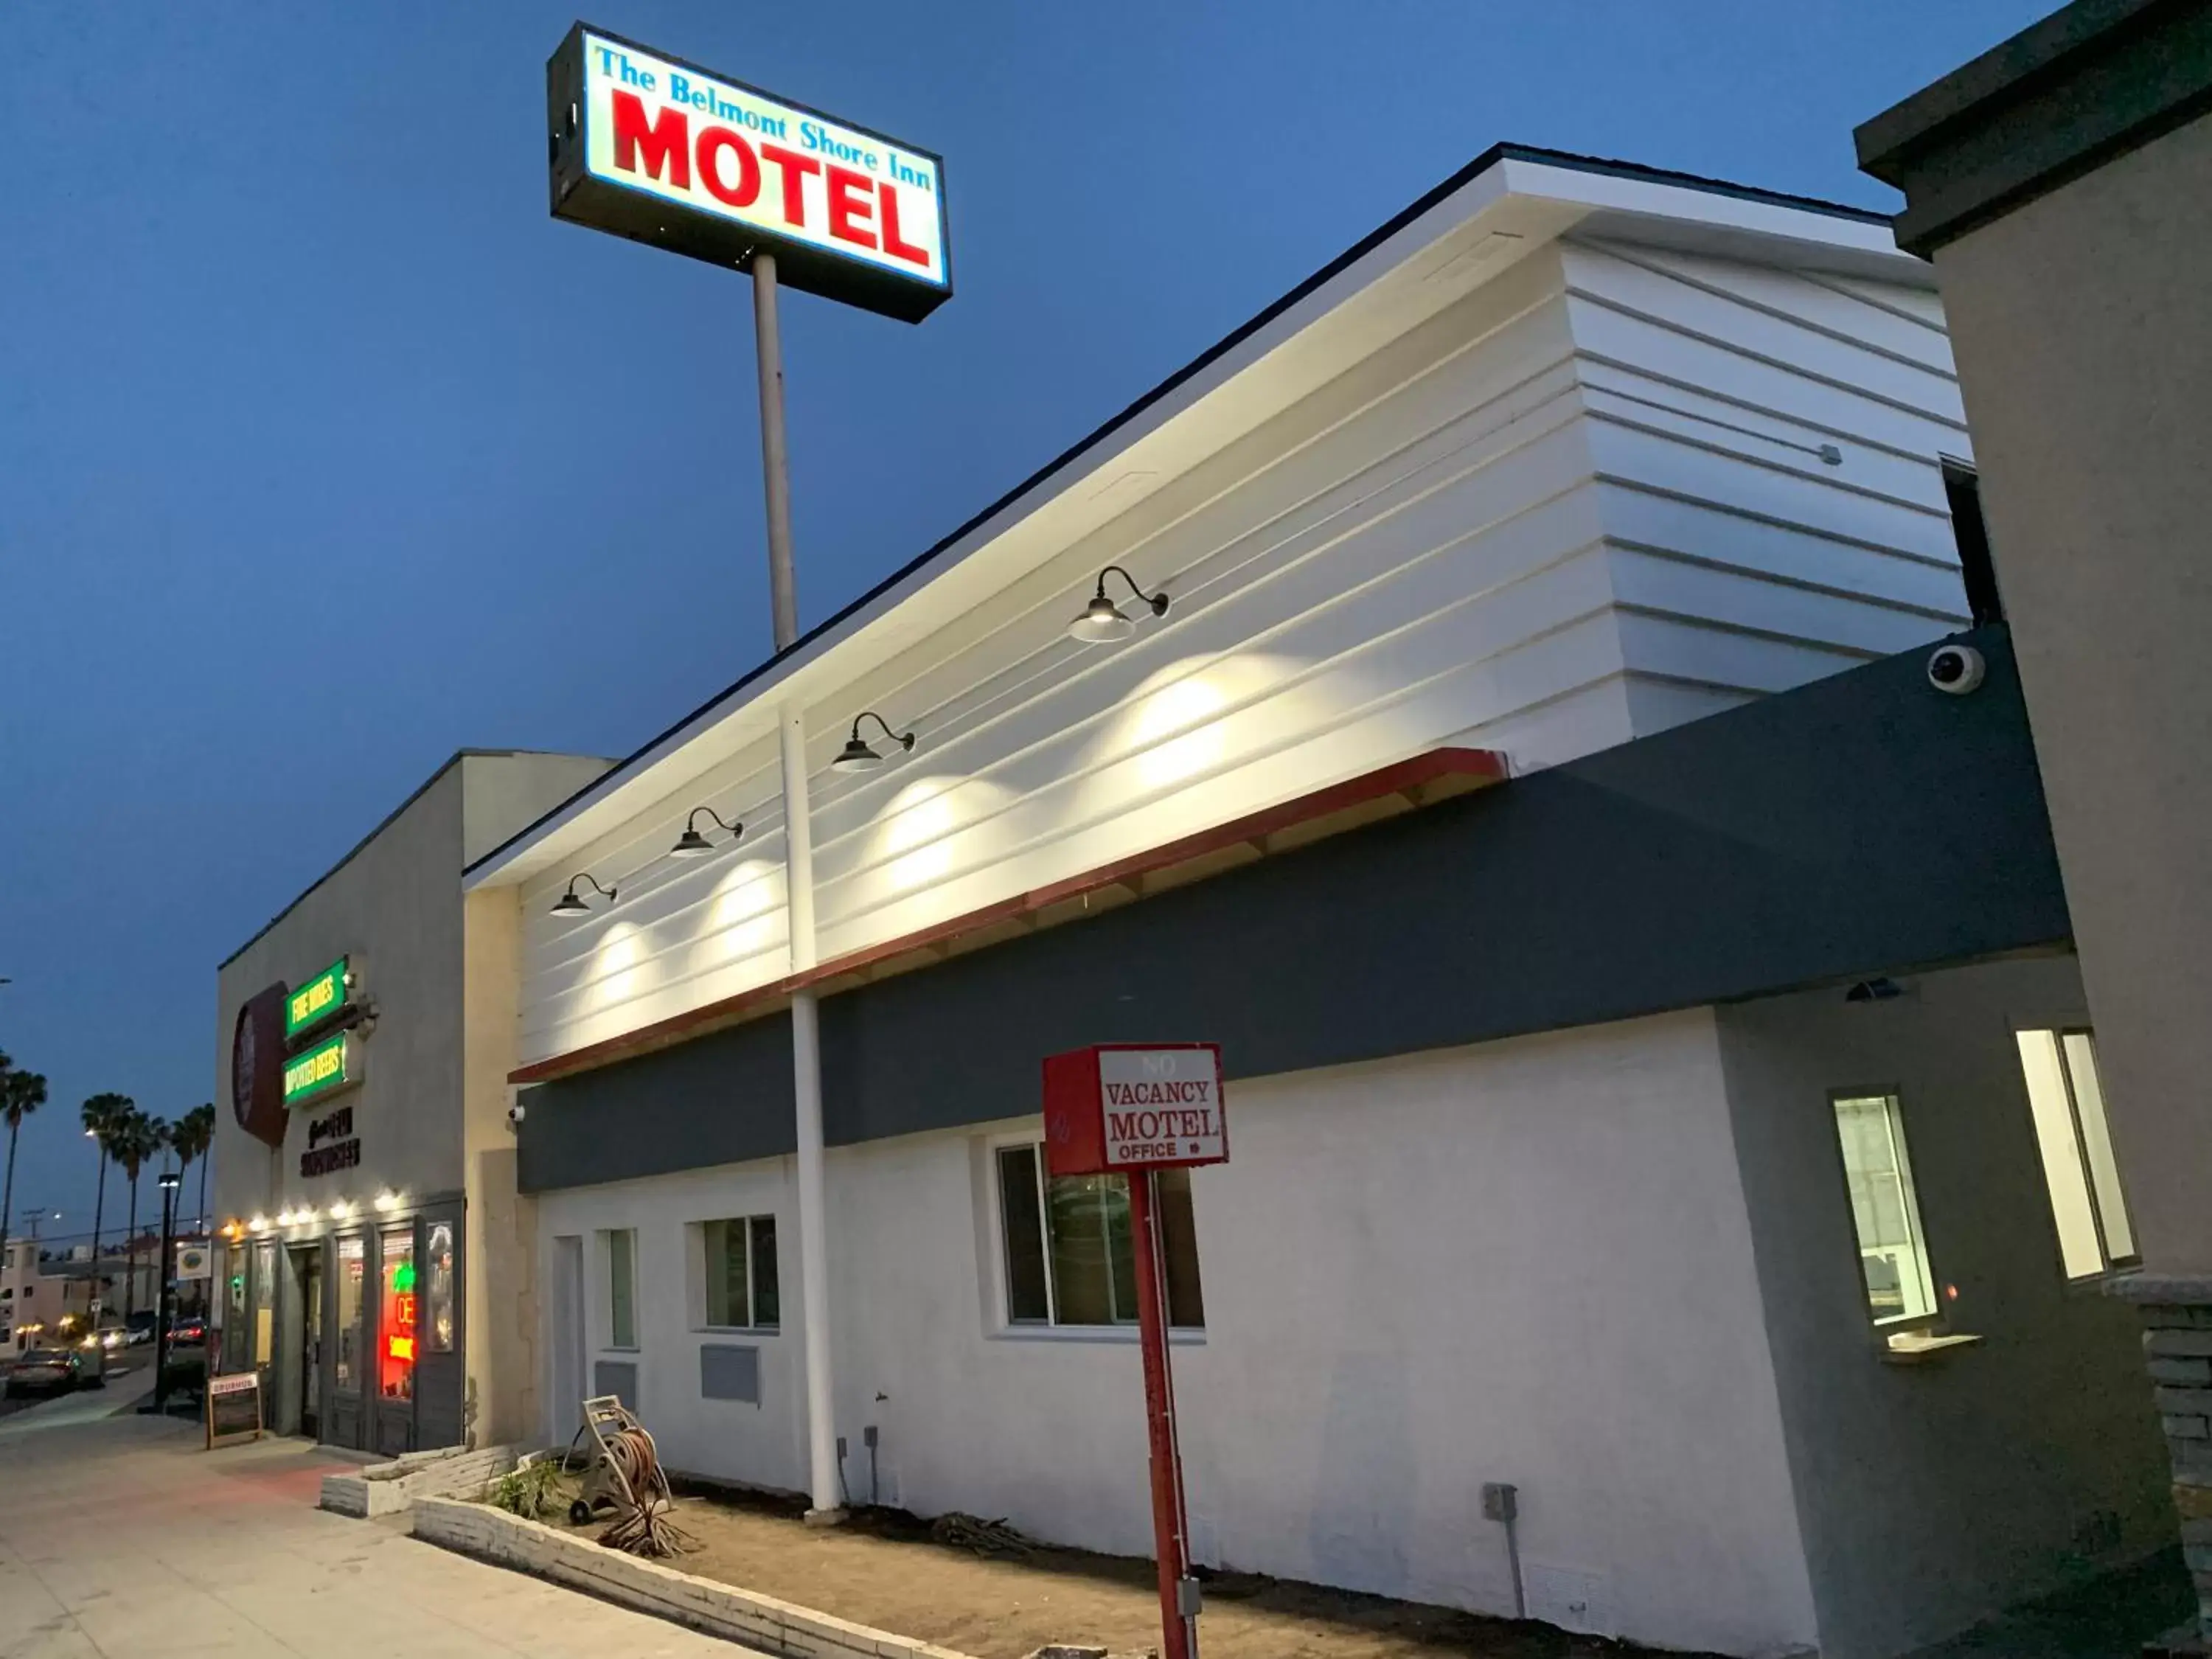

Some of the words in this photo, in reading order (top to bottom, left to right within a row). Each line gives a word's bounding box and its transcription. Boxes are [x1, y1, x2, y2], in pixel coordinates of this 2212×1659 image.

[595, 45, 655, 92] The
[670, 73, 787, 141] Belmont
[800, 120, 878, 170] Shore
[888, 153, 931, 192] Inn
[612, 88, 929, 268] MOTEL
[1144, 1054, 1176, 1077] NO
[1106, 1081, 1209, 1105] VACANCY
[1109, 1109, 1219, 1141] MOTEL
[1119, 1143, 1176, 1159] OFFICE
